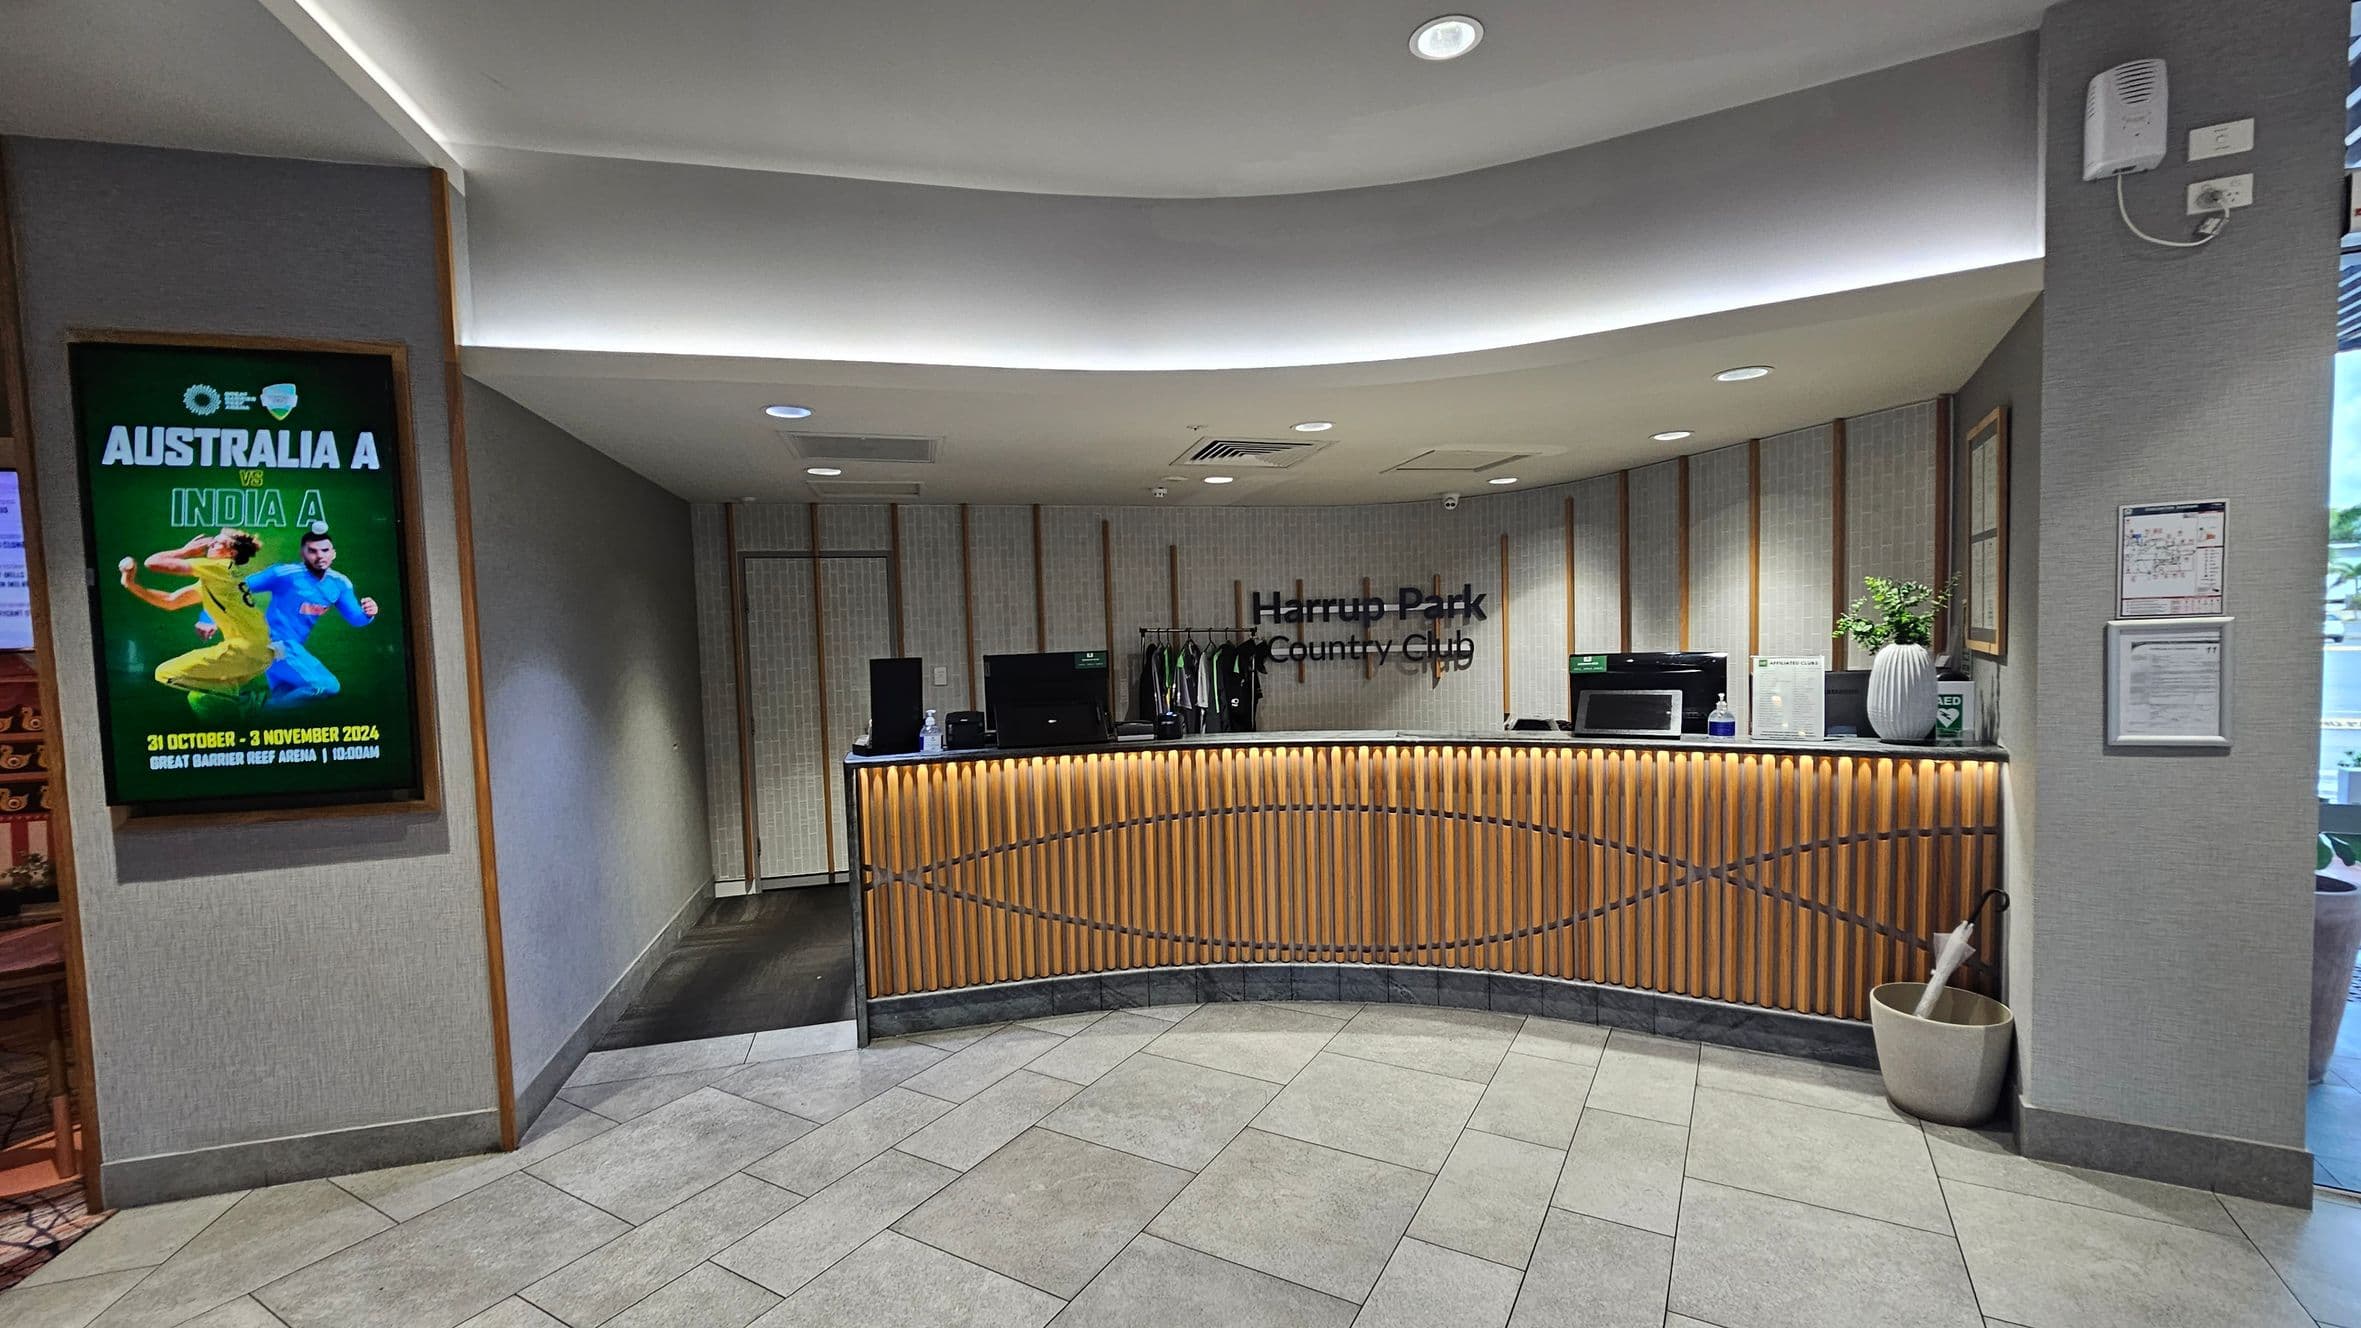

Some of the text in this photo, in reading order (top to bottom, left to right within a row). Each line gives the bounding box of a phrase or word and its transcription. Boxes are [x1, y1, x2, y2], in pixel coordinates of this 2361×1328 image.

[102, 425, 380, 470] AUSTRALIA A
[239, 470, 264, 487] VS
[171, 488, 327, 528] INDIA A
[1252, 583, 1488, 627] Harrup Park
[1269, 630, 1475, 665] Country Club
[147, 734, 163, 751] 31
[167, 731, 236, 750] OCTOBER
[250, 730, 261, 747] 3
[264, 726, 339, 746] NOVEMBER
[342, 725, 380, 742] 2024
[150, 754, 190, 770] GREAT
[192, 751, 245, 768] BARRIER
[247, 750, 276, 765] REEF
[278, 748, 317, 763] ARENA
